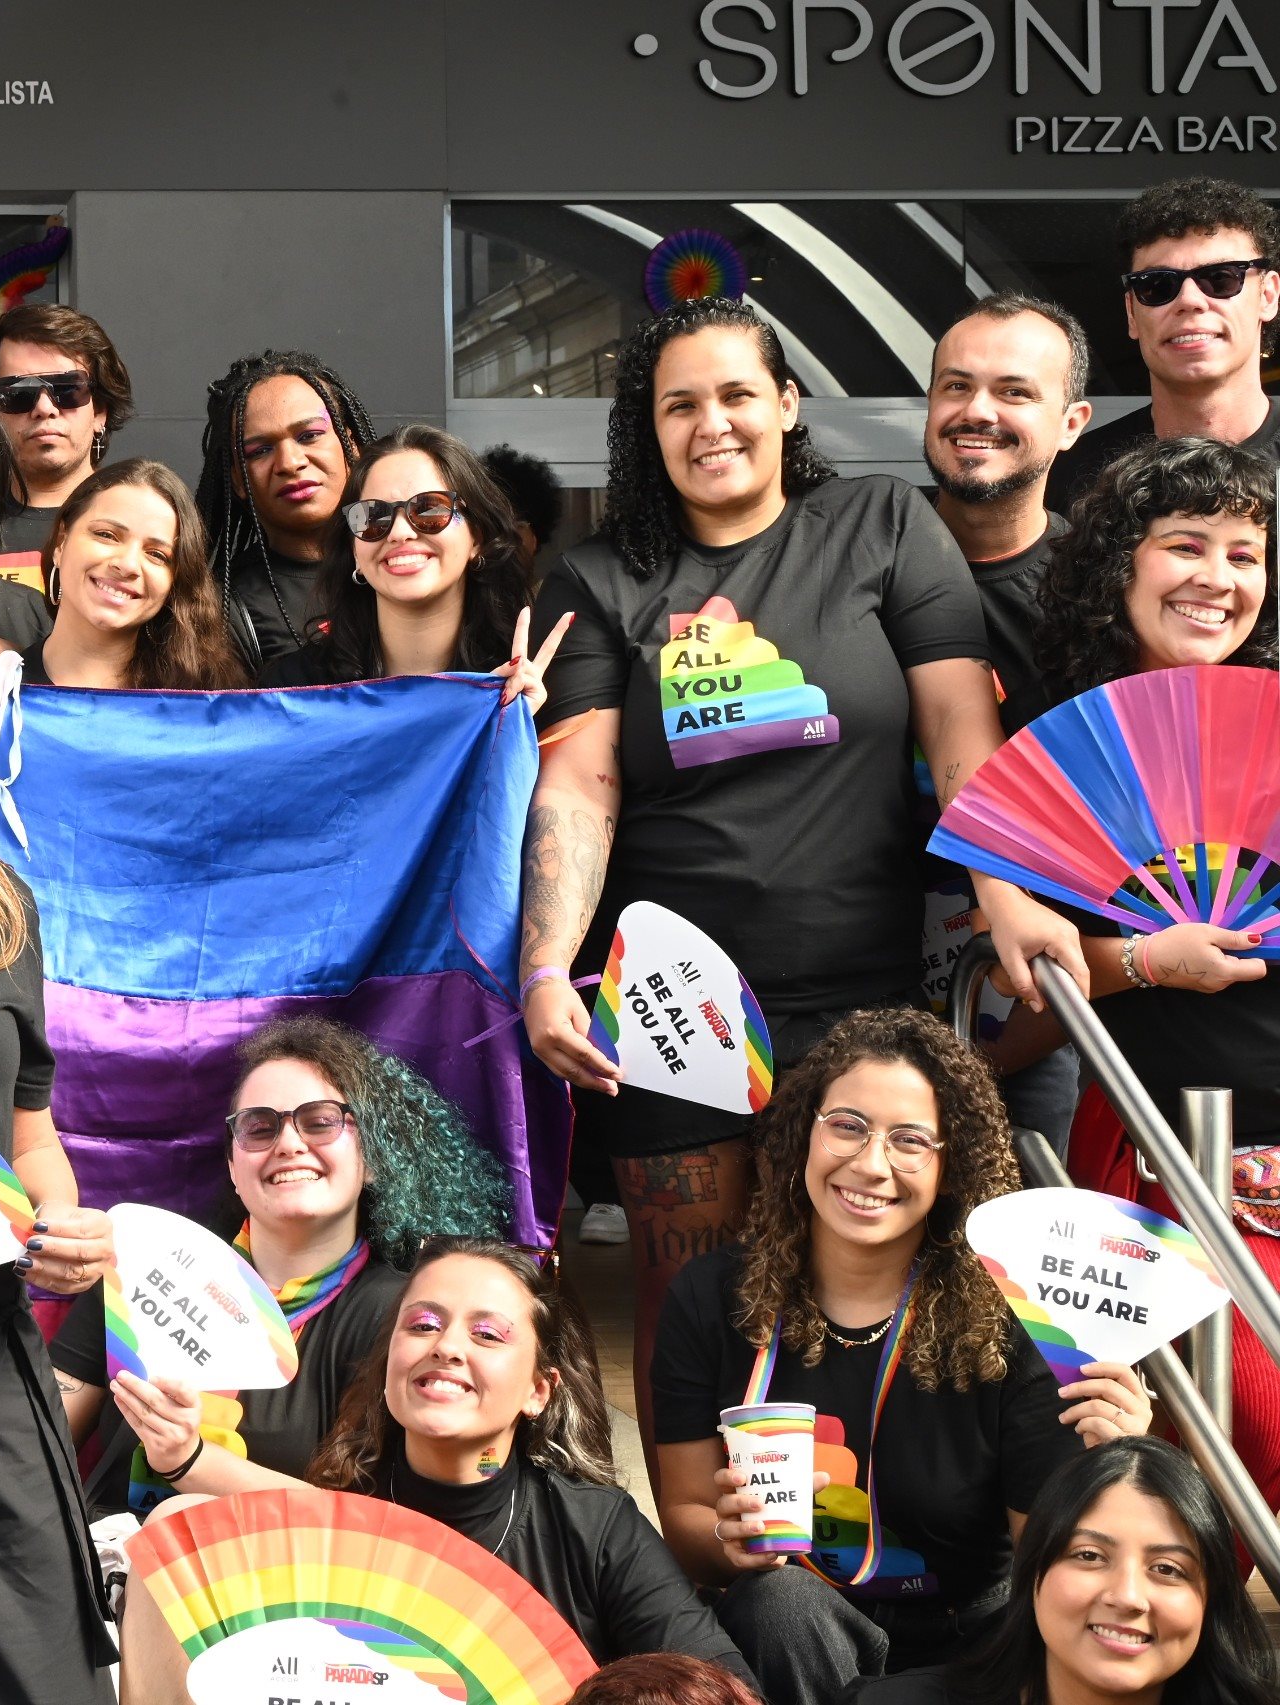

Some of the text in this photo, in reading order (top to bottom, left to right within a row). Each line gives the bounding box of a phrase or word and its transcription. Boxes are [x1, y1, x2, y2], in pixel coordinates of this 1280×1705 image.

[1017, 115, 1278, 153] PIZZA BAR
[673, 623, 711, 644] BE
[672, 650, 731, 670] ALL
[670, 674, 742, 700] YOU
[675, 701, 746, 734] ARE
[923, 975, 951, 996] YO
[645, 972, 696, 1046] BE ALL
[624, 982, 687, 1075] YOU ARE
[1099, 1236, 1161, 1263] PARADASP
[1041, 1254, 1128, 1291] BE ALL
[145, 1267, 210, 1332] BE ALL
[1036, 1282, 1149, 1325] YOU ARE
[130, 1285, 212, 1367] YOU ARE
[749, 1472, 781, 1486] ALL
[764, 1490, 798, 1505] ARE
[324, 1666, 389, 1686] PARADASP
